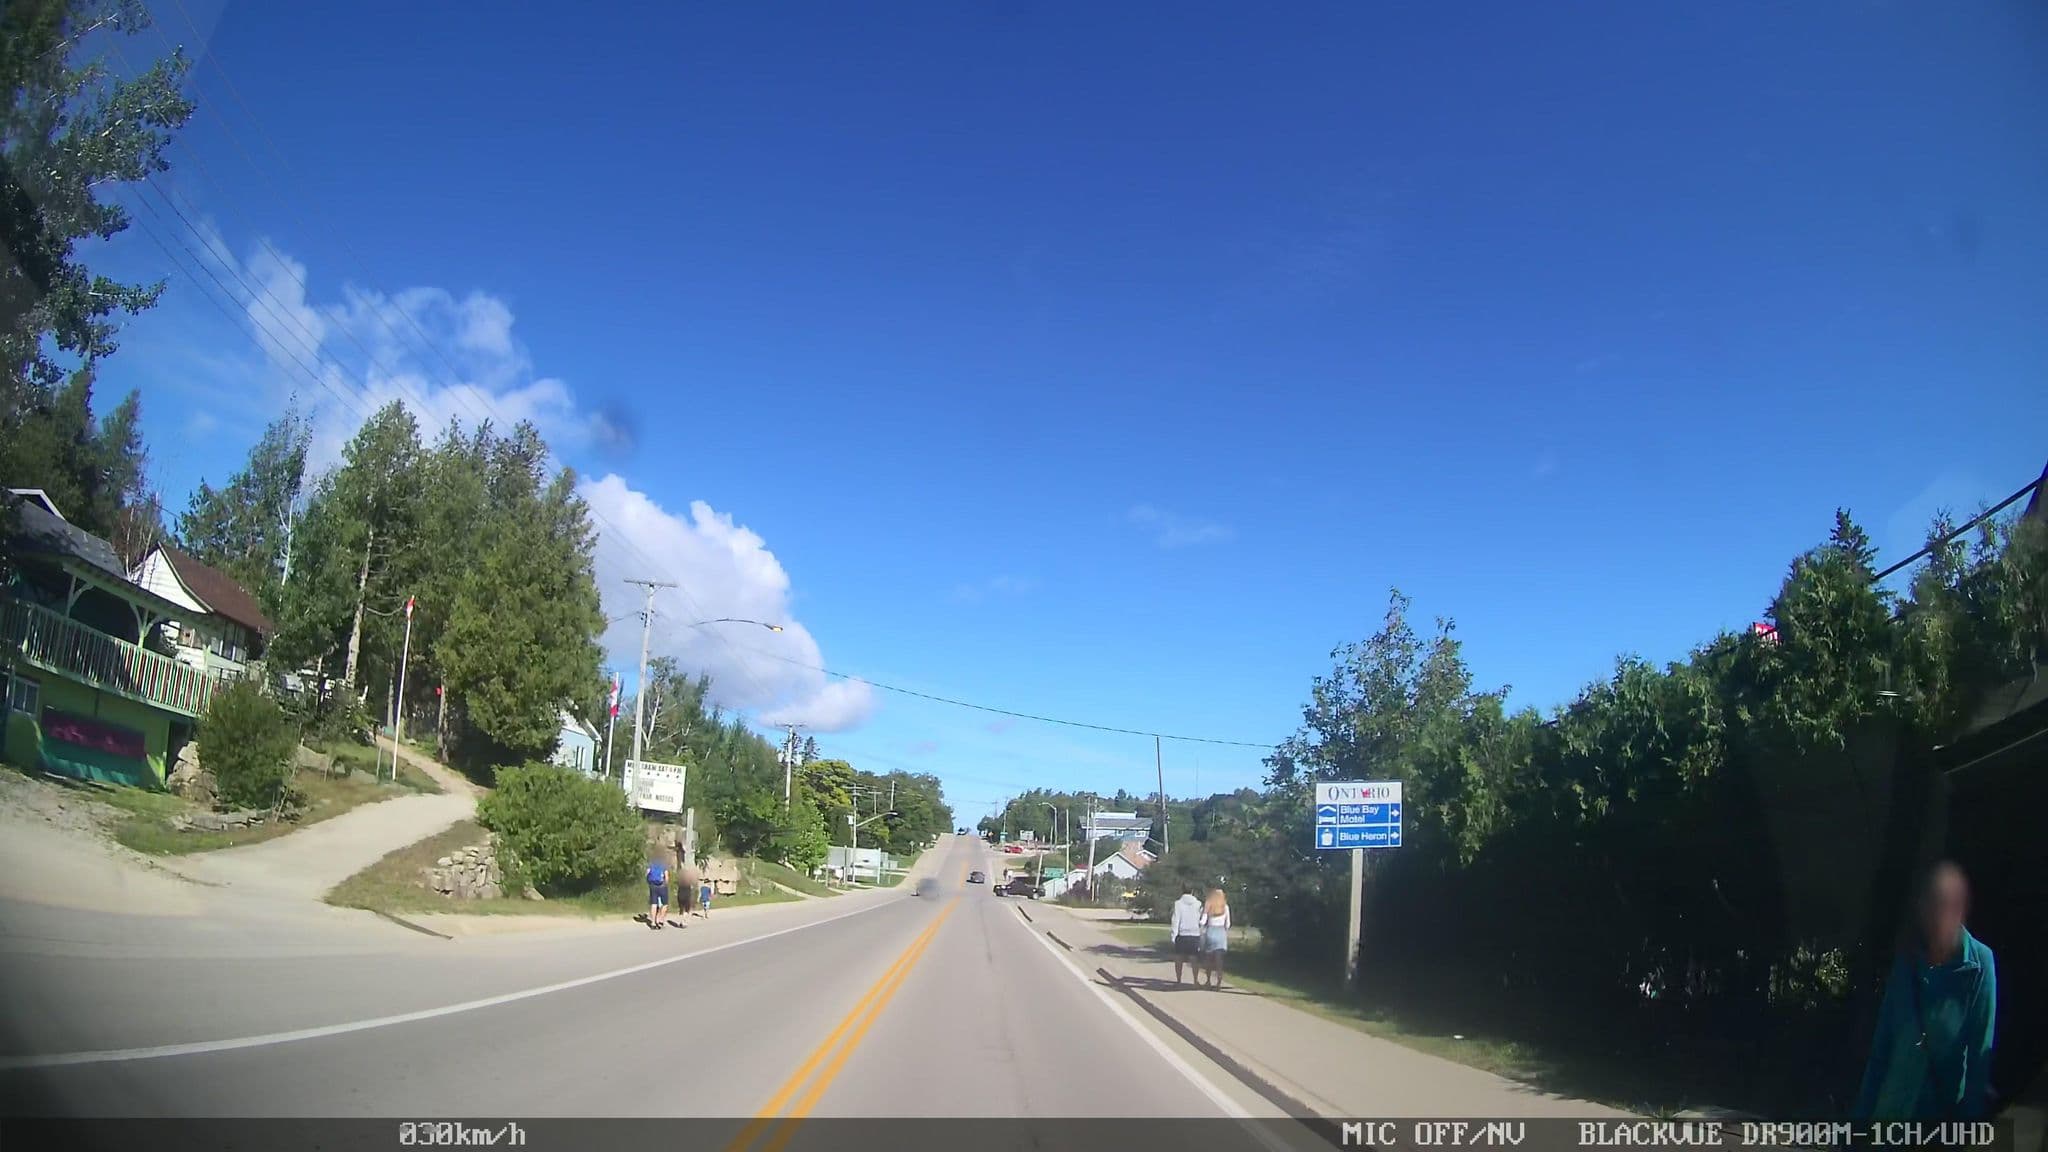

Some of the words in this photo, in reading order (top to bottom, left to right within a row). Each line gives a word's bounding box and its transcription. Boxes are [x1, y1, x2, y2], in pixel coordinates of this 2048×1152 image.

[1340, 805, 1360, 814] Blue
[1362, 805, 1380, 816] Bay
[1340, 815, 1366, 824] Motel
[1339, 832, 1360, 841] Blue
[1361, 831, 1388, 841] Heron
